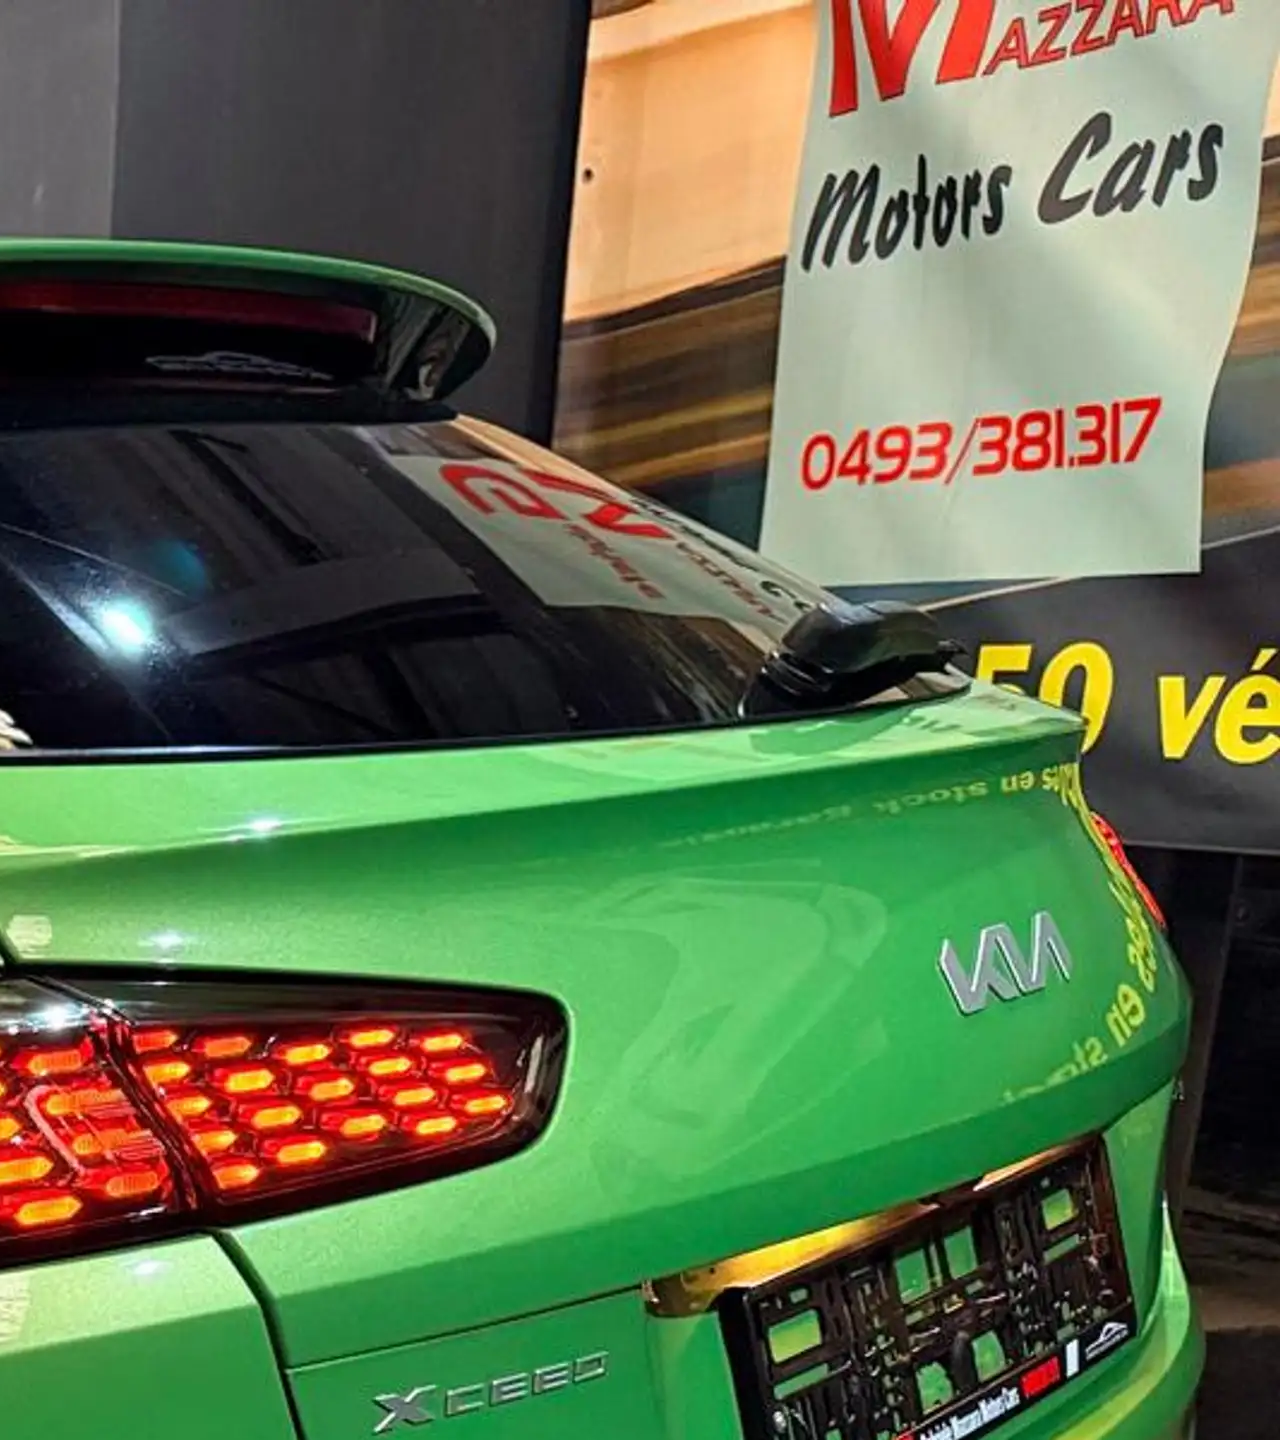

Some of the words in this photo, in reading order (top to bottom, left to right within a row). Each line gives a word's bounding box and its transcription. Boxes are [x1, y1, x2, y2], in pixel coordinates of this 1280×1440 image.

[801, 153, 1013, 271] Motors
[1037, 111, 1224, 225] Cars
[801, 396, 1162, 491] 0493/381.317
[936, 911, 1074, 1017] KIA
